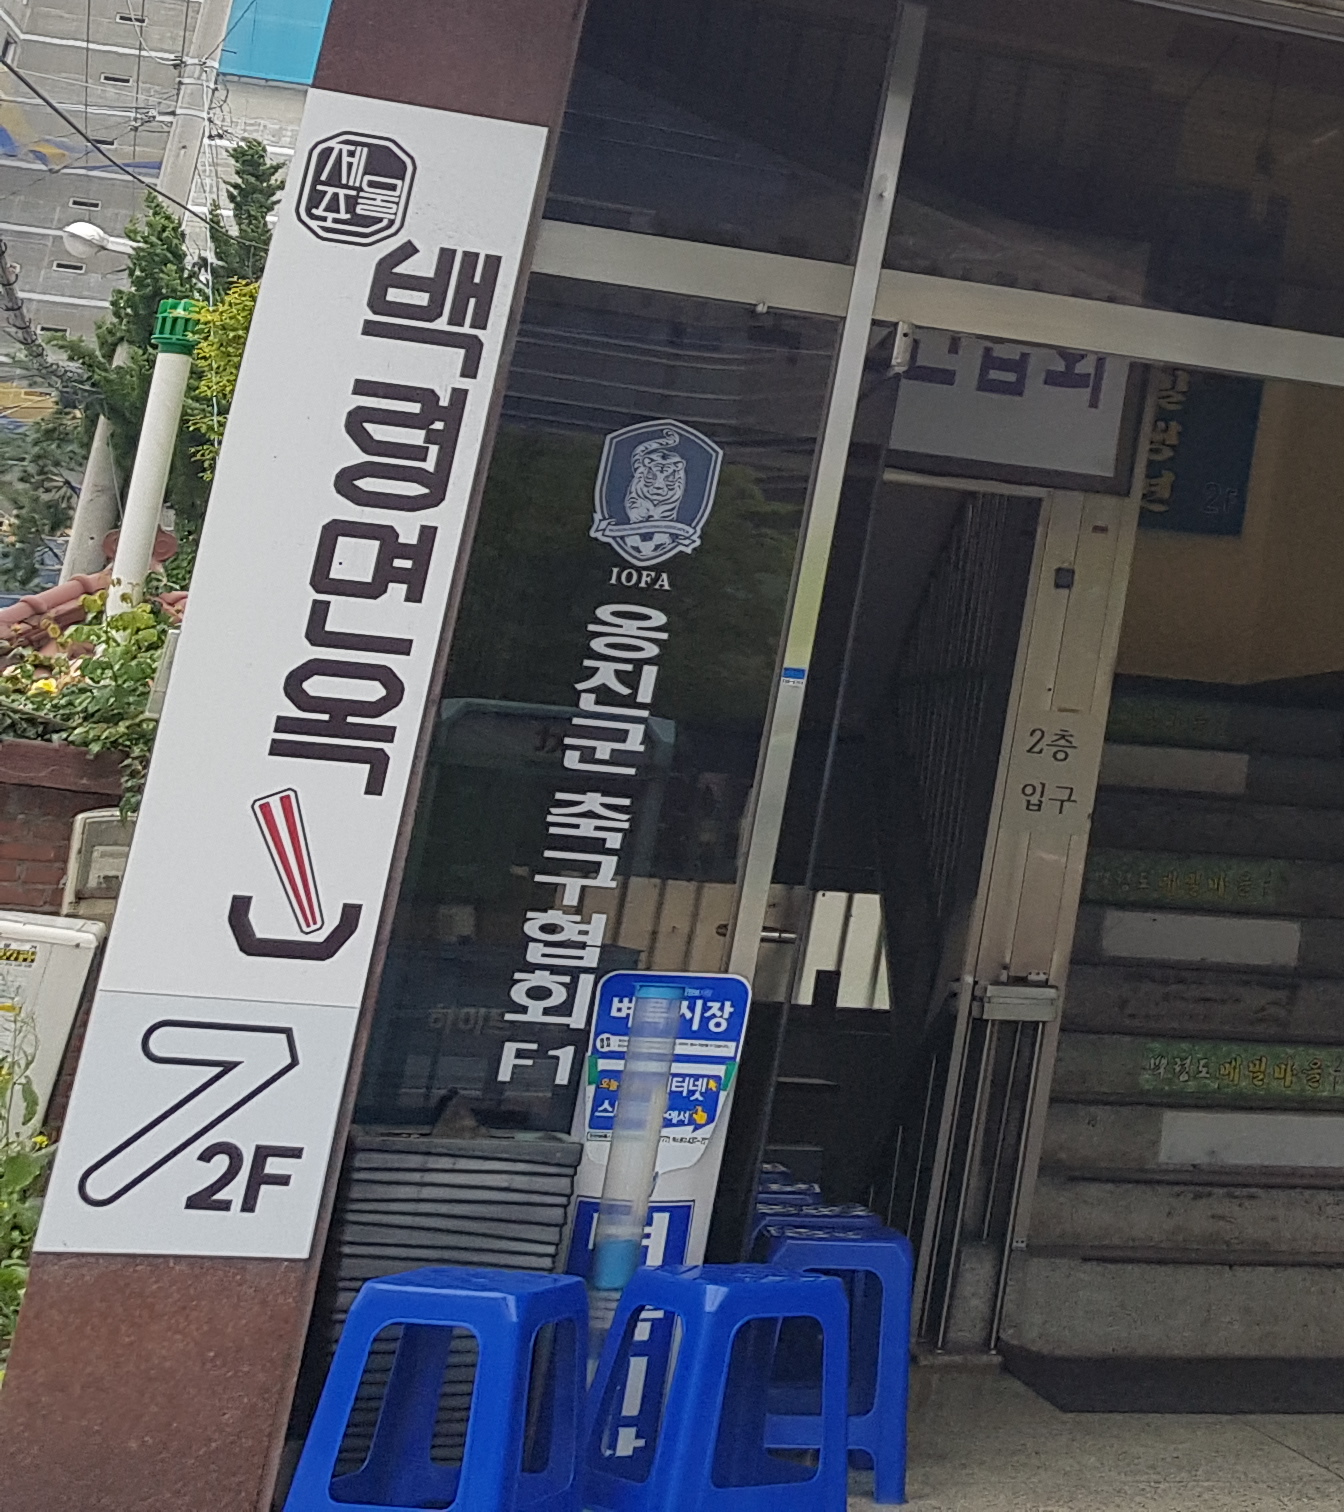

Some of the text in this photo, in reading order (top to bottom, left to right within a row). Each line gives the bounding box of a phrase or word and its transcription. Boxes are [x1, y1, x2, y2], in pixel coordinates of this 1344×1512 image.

[268, 239, 503, 797] 백령면옥
[609, 567, 671, 590] IOFA
[563, 602, 670, 776] 옹진군
[1029, 727, 1077, 763] 2층
[1021, 782, 1079, 815] 입구
[503, 791, 633, 1030] 축구협회
[610, 997, 735, 1032] 벼시장
[497, 1041, 575, 1087] F1
[184, 1140, 304, 1215] 2F
